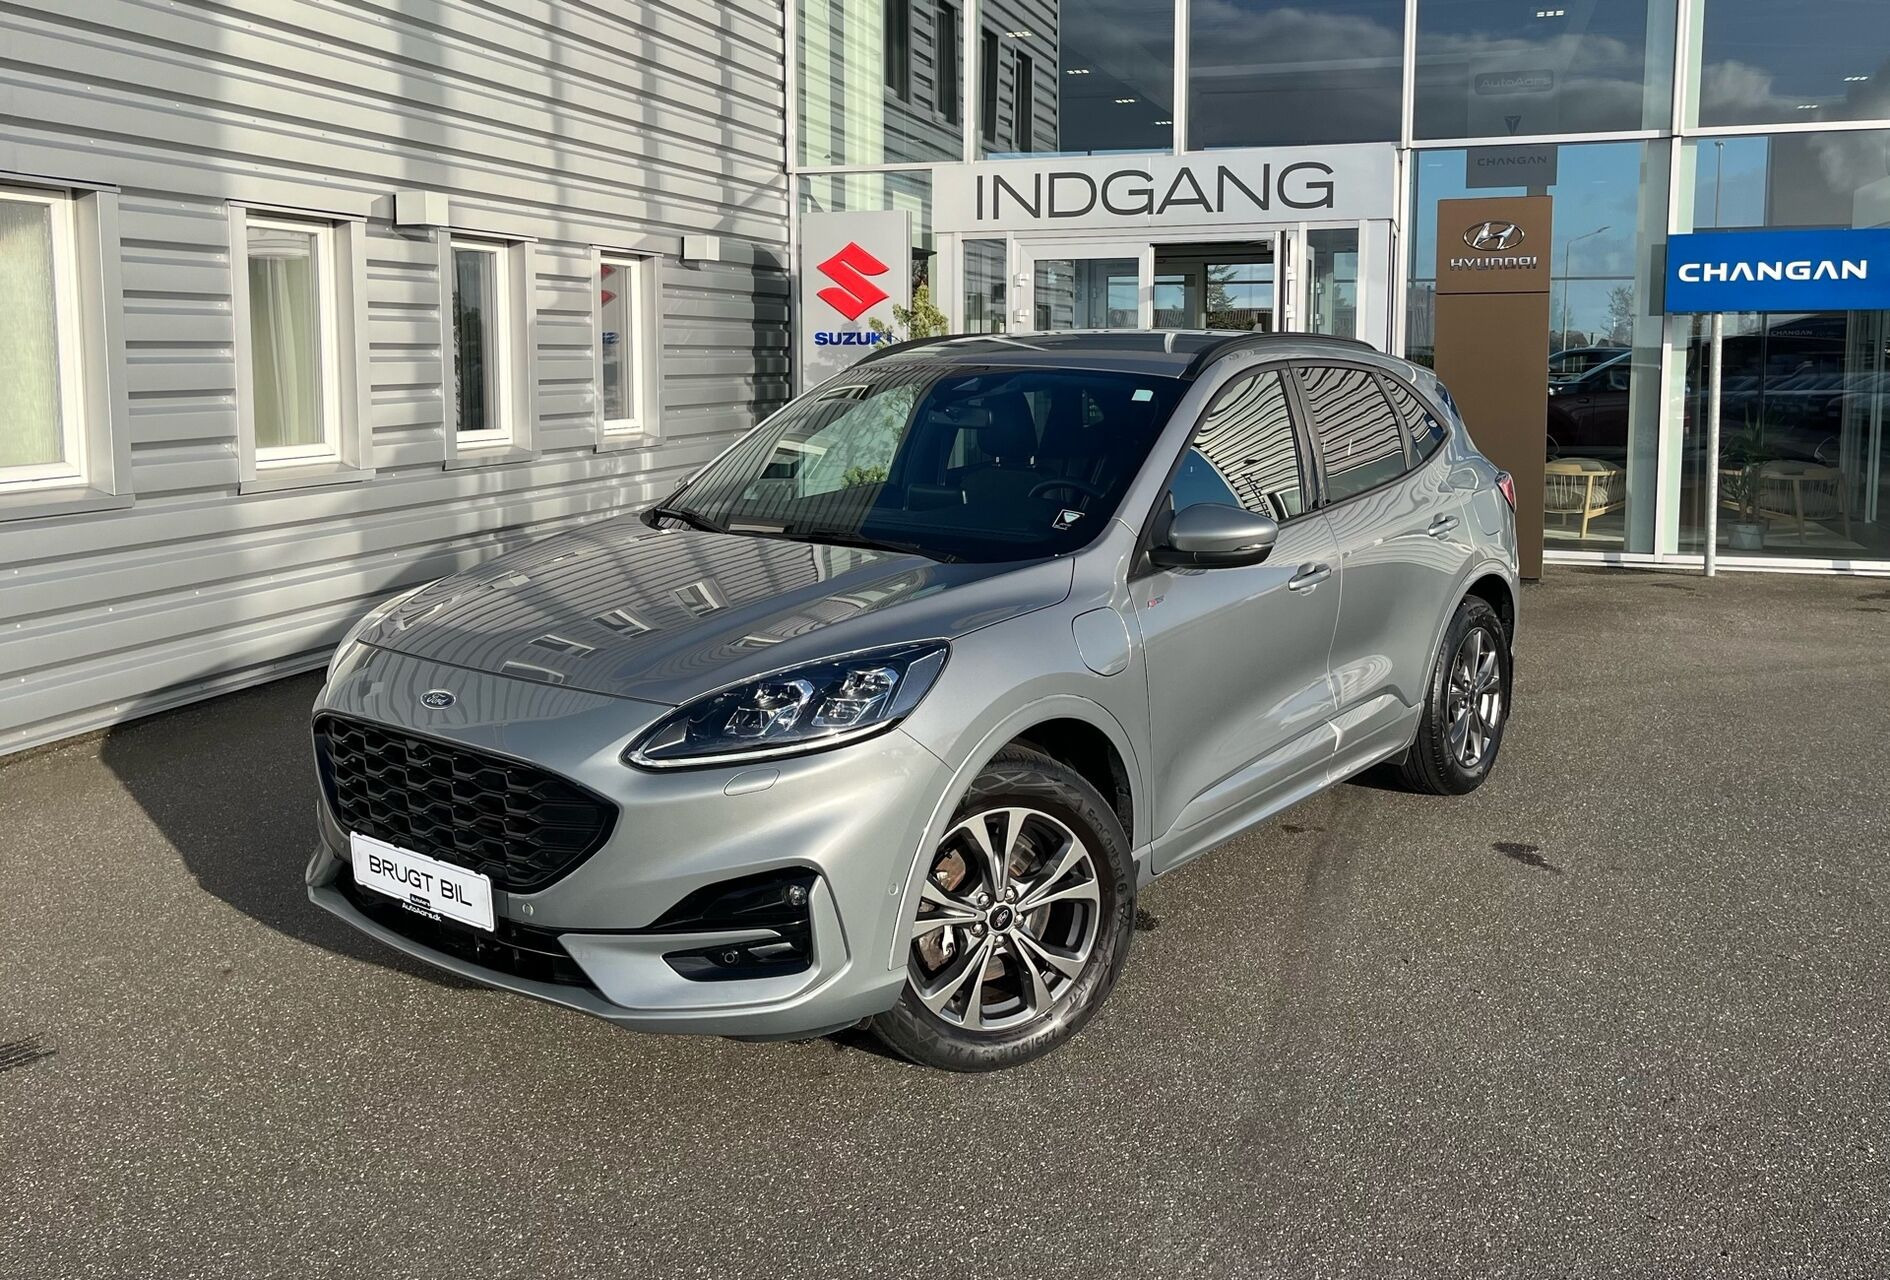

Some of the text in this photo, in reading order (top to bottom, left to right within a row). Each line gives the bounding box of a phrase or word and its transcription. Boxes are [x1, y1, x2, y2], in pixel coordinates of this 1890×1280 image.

[1477, 155, 1547, 167] CHANGAN
[976, 161, 1335, 221] INDGANG
[1450, 256, 1537, 271] HYUNDAI
[1678, 259, 1868, 283] CHANGAN
[1770, 329, 1813, 337] CHANGAN
[369, 854, 433, 892] BRUGT
[440, 879, 472, 907] BIL
